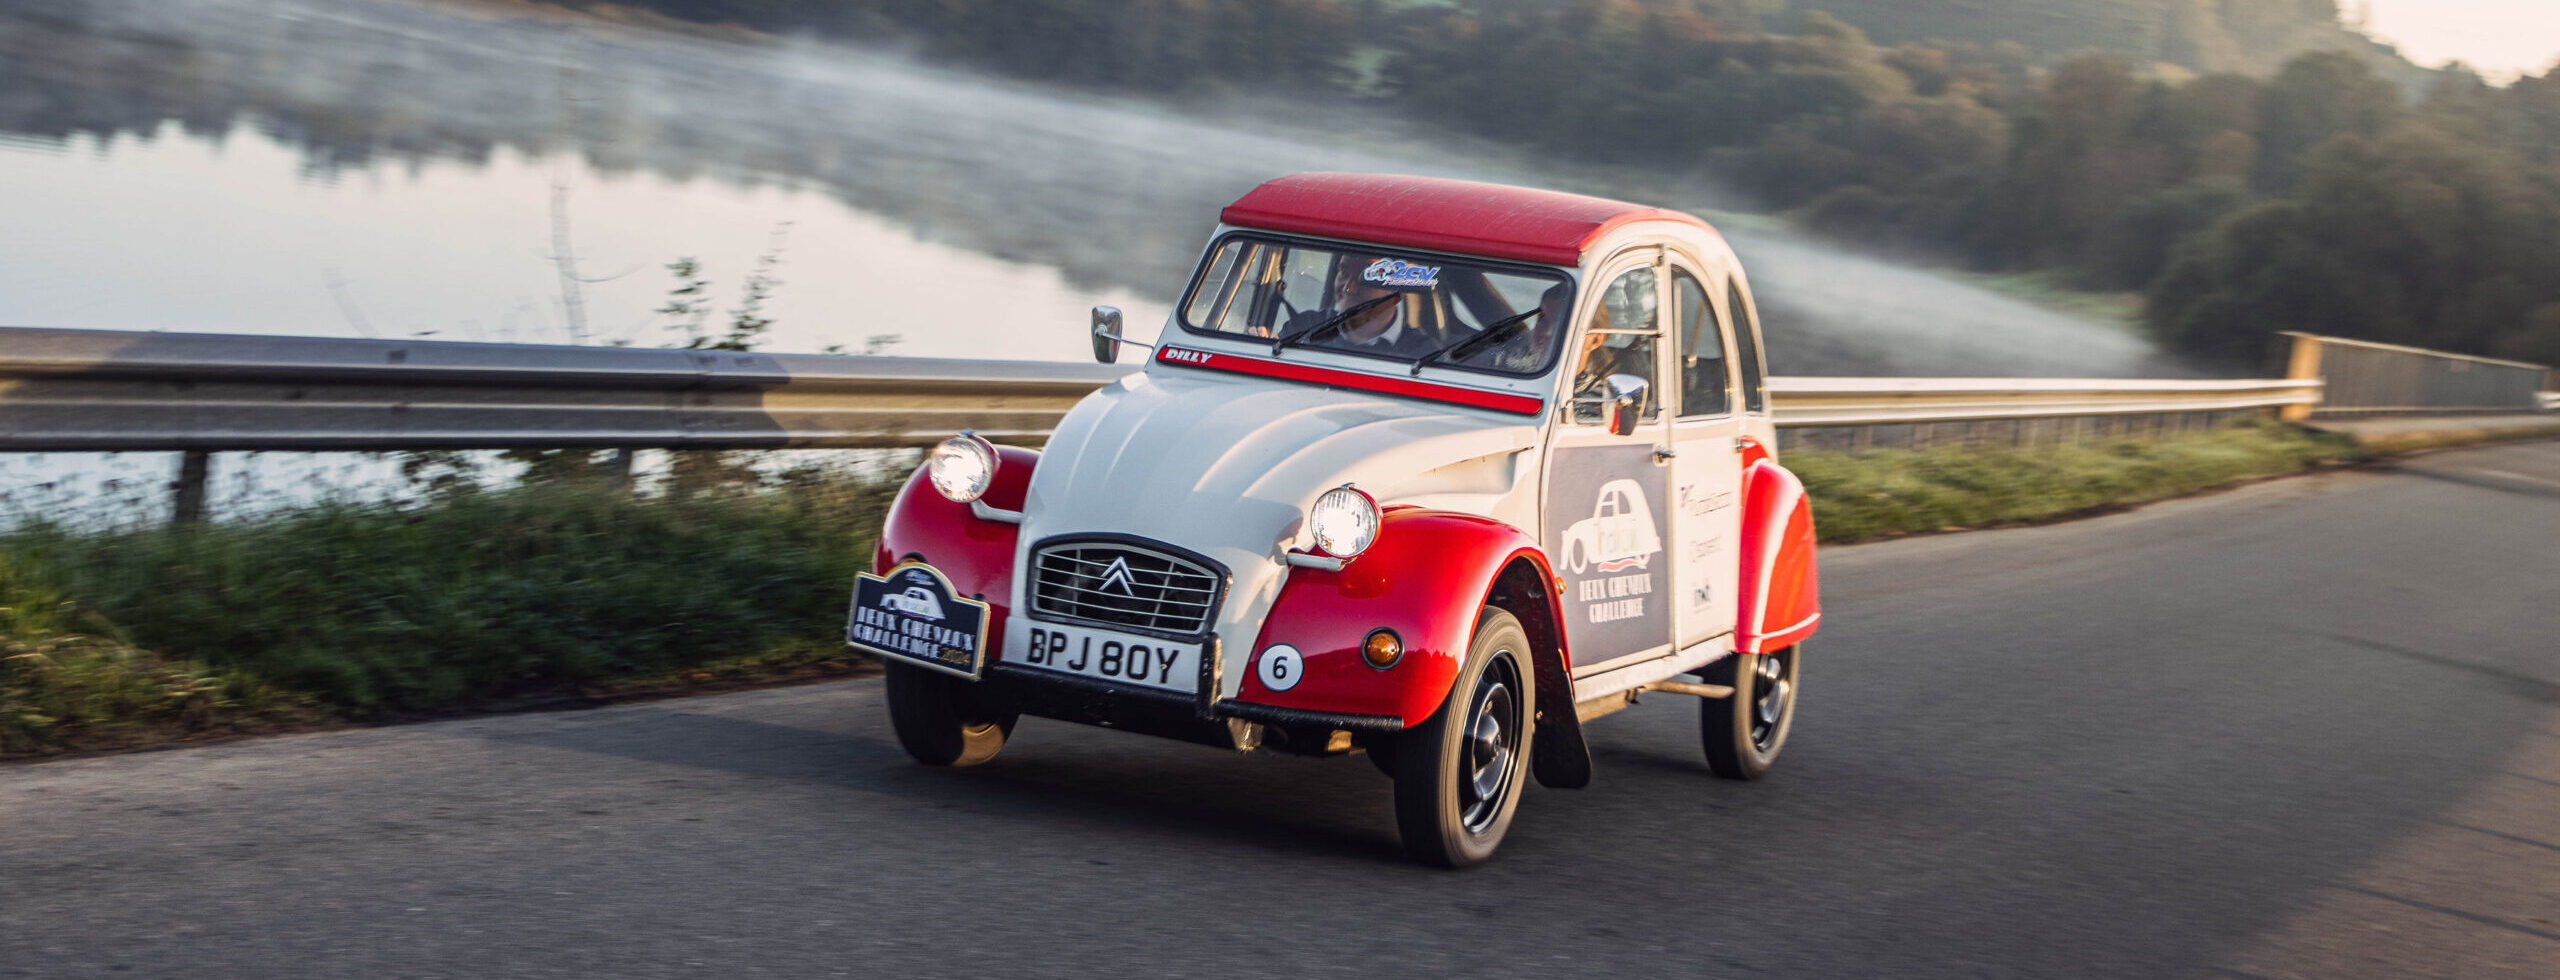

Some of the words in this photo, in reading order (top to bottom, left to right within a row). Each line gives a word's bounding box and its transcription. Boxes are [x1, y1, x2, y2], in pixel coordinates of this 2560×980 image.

[1165, 349, 1212, 364] DILLY
[856, 606, 898, 631] DEUX
[853, 623, 941, 659] CHALLENGE
[1027, 627, 1091, 671] BPJ
[1100, 640, 1179, 684] 80Y
[1272, 655, 1288, 680] 6
